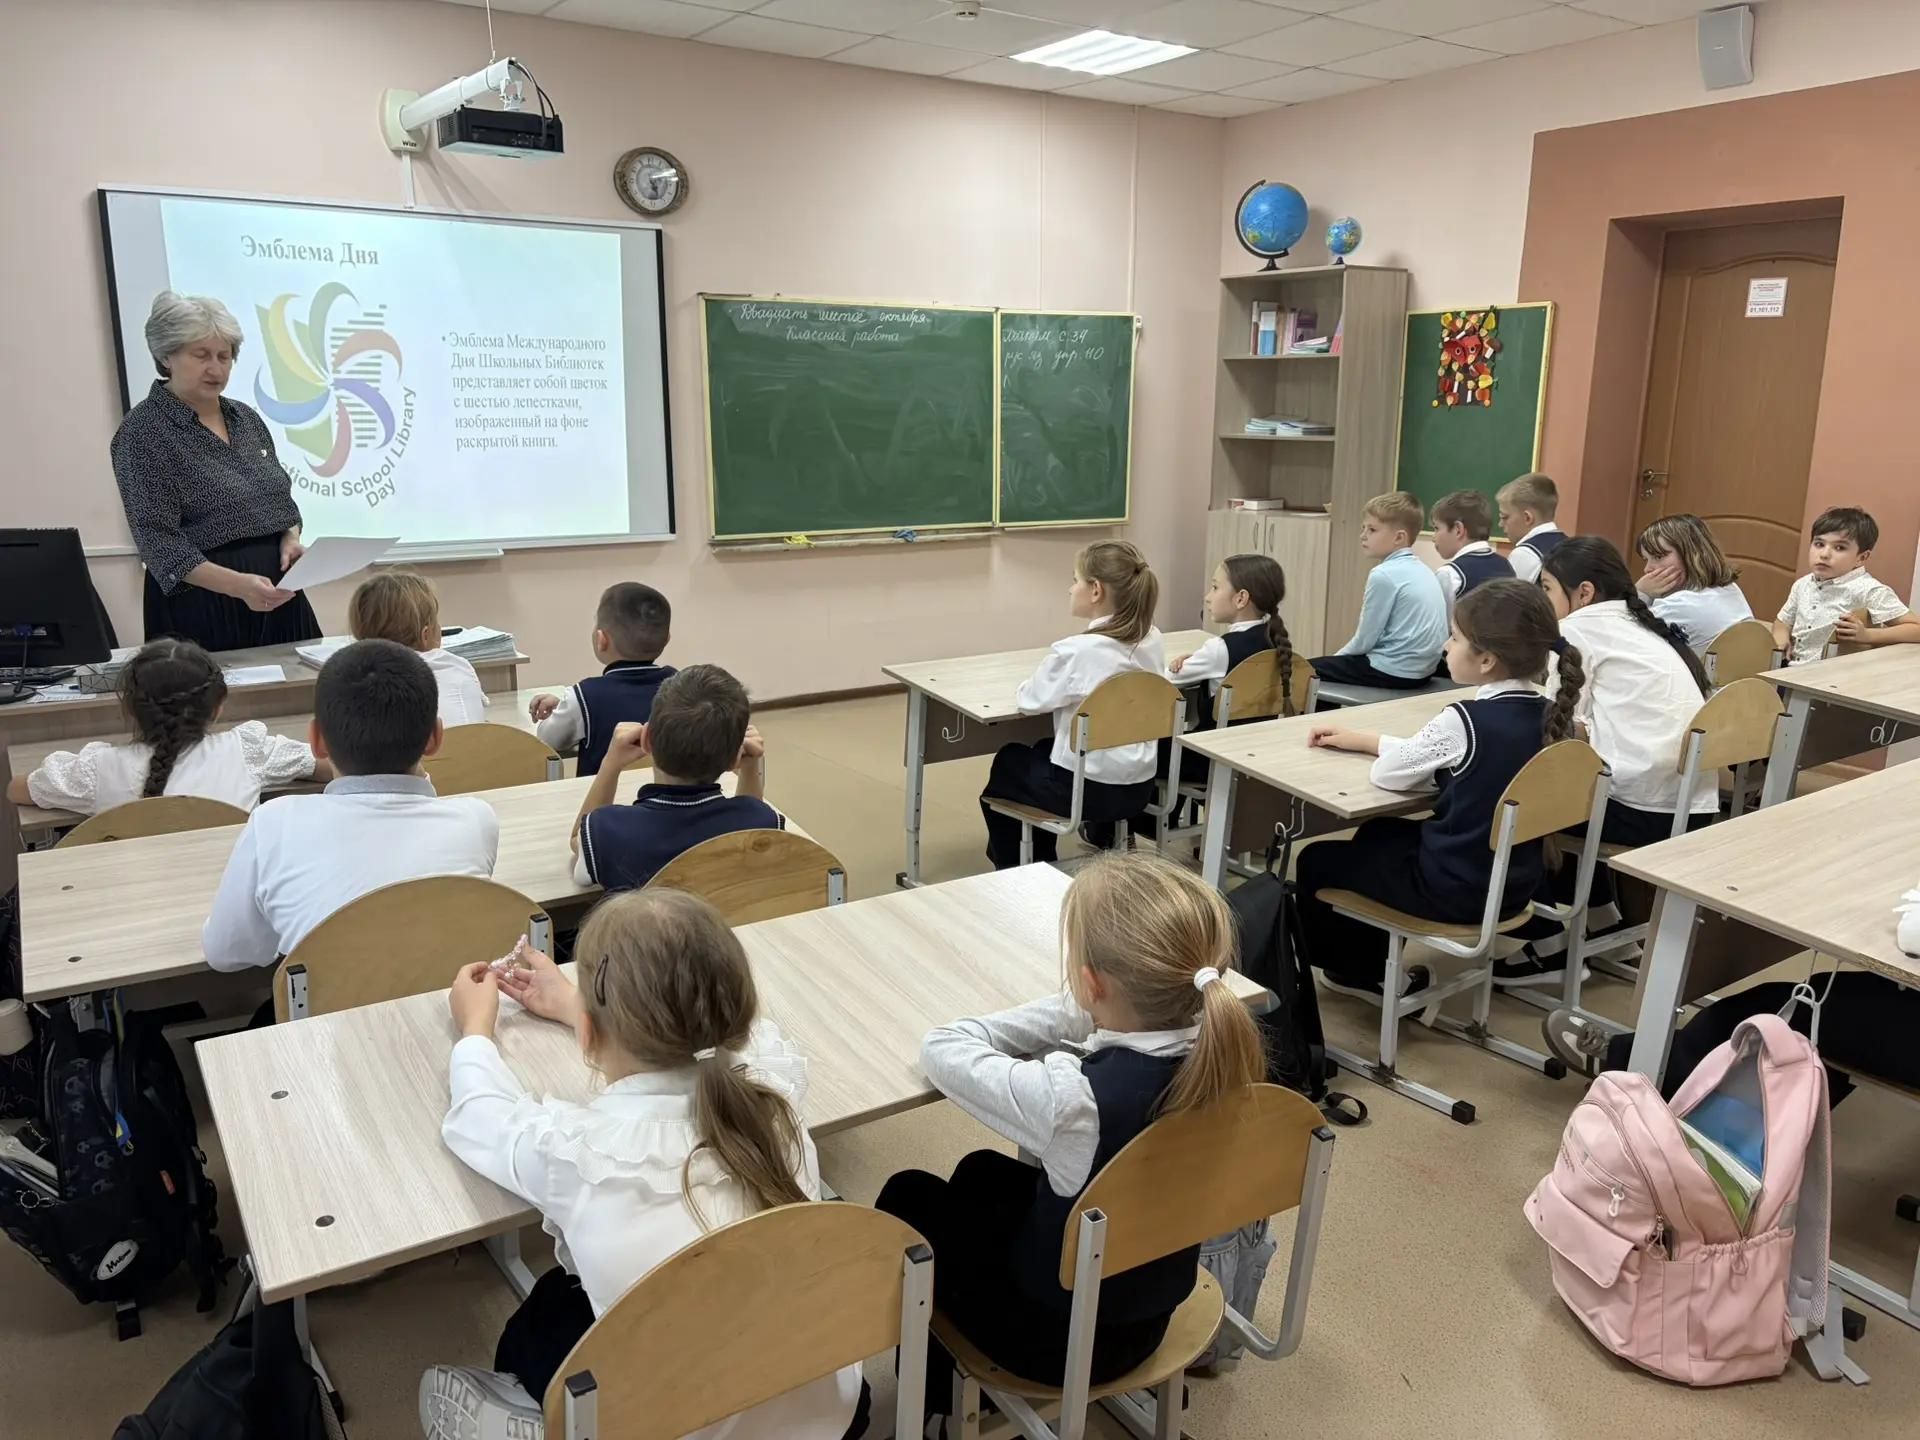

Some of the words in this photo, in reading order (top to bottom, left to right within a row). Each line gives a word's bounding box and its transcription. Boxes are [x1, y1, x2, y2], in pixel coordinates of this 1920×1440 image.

[240, 235, 334, 262] Эмблема
[340, 242, 379, 269] Дня
[449, 332, 504, 348] Эмблема
[507, 334, 607, 352] Международного
[851, 325, 899, 349] работа
[451, 353, 475, 369] Дня
[479, 354, 542, 369] Школьных
[545, 355, 605, 370] Библиотек
[452, 376, 531, 391] представляет
[533, 374, 567, 390] собой
[570, 377, 608, 391] цветок
[453, 397, 461, 408] с
[464, 397, 510, 409] шестью
[513, 397, 582, 411] лепестками,
[455, 413, 542, 431] изображенный
[544, 416, 558, 428] на
[560, 413, 590, 431] фоне
[341, 456, 396, 497] School
[390, 386, 417, 458] Library
[456, 434, 519, 452] раскрытой
[522, 434, 559, 448] книги.
[366, 478, 396, 508] Day
